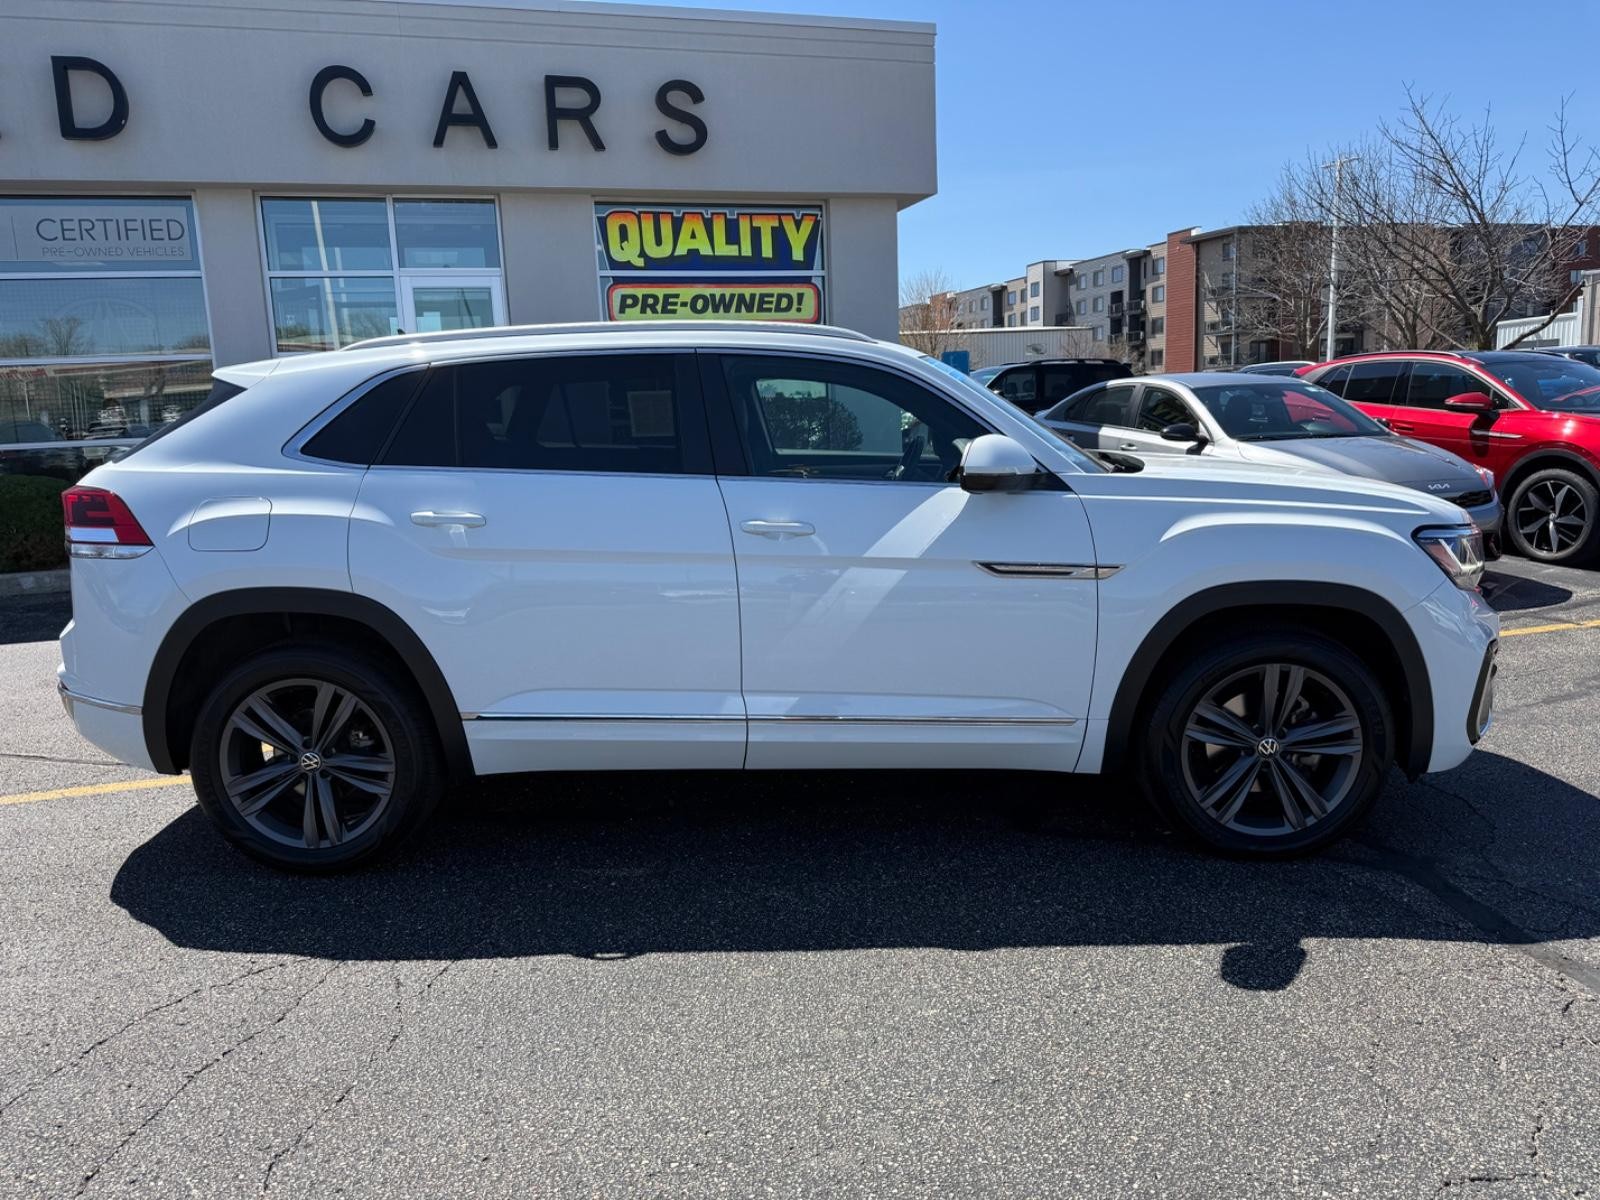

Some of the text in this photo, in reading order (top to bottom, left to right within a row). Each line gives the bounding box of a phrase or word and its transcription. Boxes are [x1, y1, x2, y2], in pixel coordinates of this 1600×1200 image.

[50, 55, 709, 156] D CARS
[36, 217, 185, 242] CERTIFIED
[605, 210, 817, 268] QUALITY
[42, 246, 185, 258] PRE-OWNED VEHICLES
[618, 292, 805, 315] PRE-OWNED!
